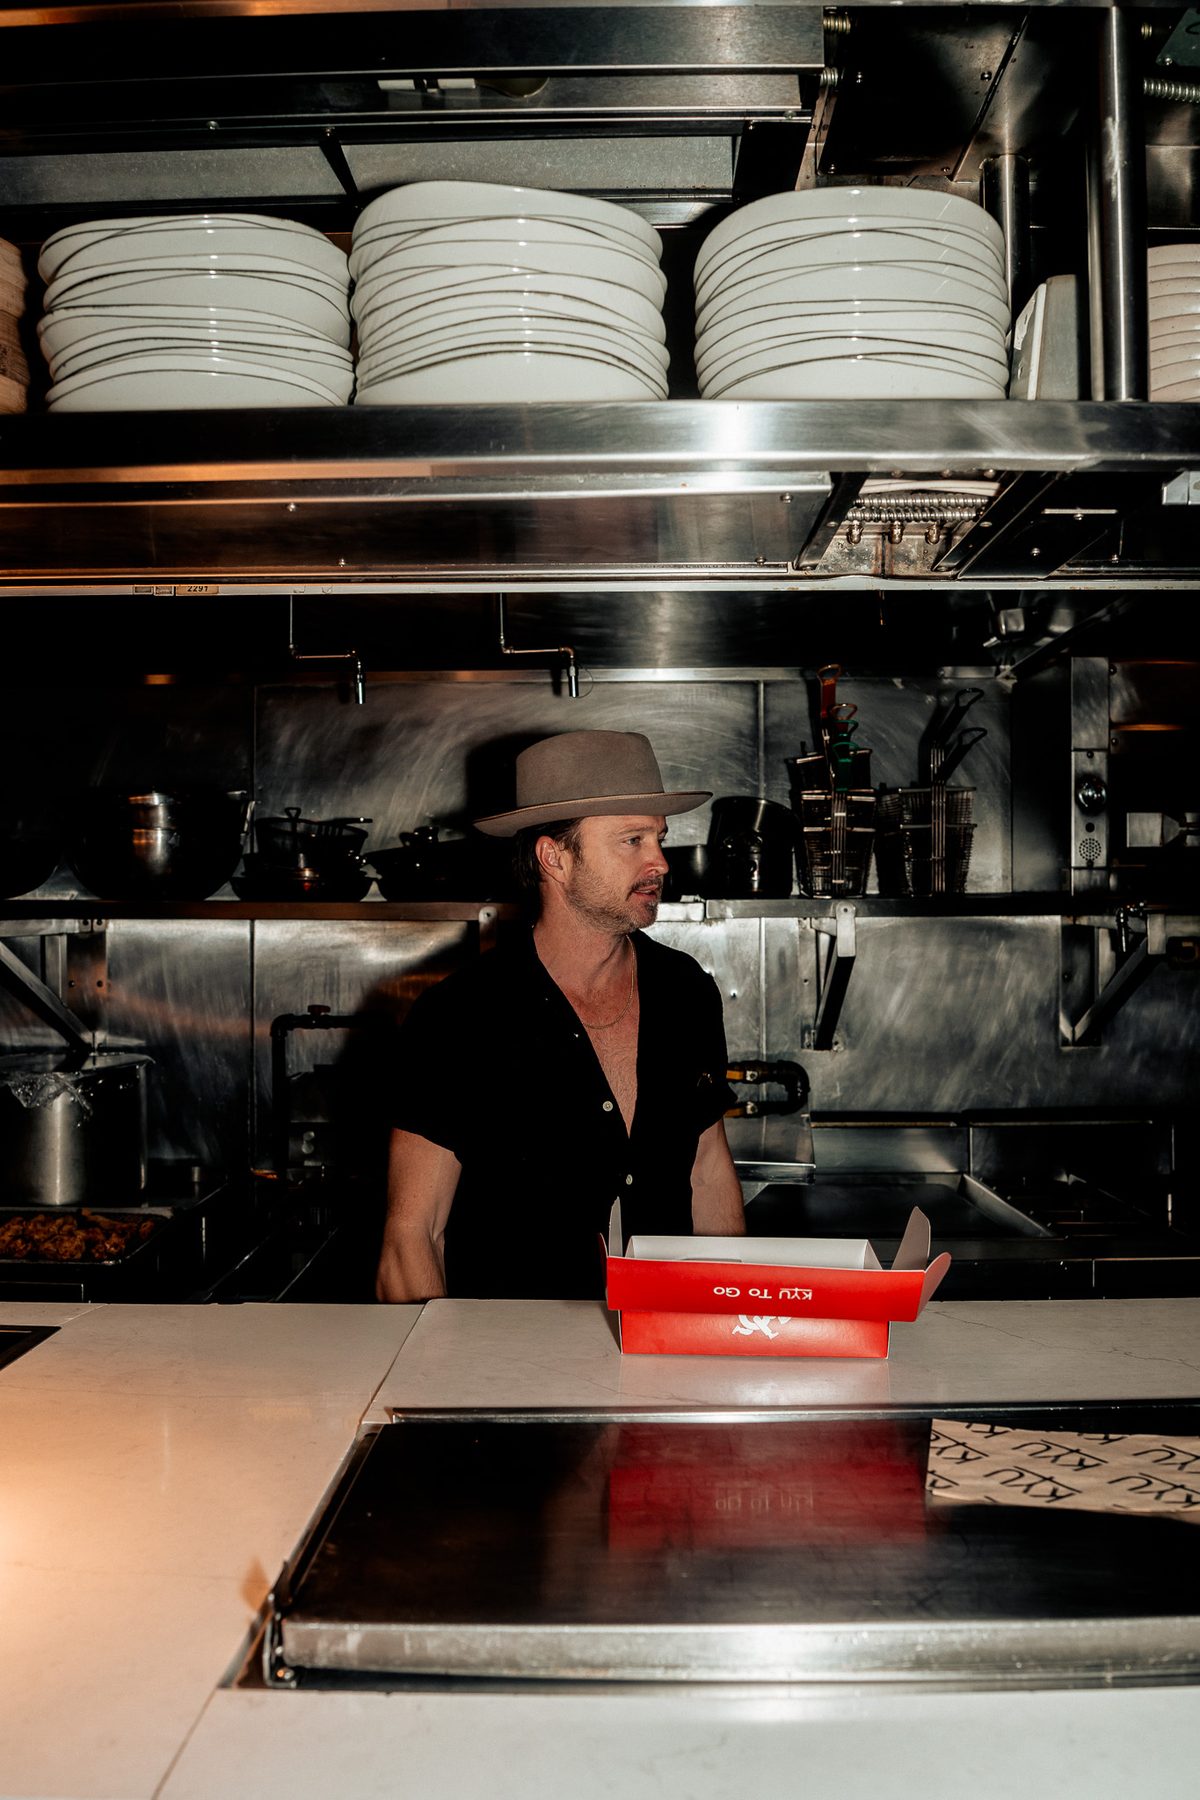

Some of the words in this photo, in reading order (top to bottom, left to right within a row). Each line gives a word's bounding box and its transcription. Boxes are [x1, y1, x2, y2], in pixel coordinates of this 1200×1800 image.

[779, 1287, 813, 1300] KYU
[1011, 1439, 1109, 1472] KYU
[1132, 1444, 1200, 1474] YU
[983, 1465, 1083, 1503] KYU
